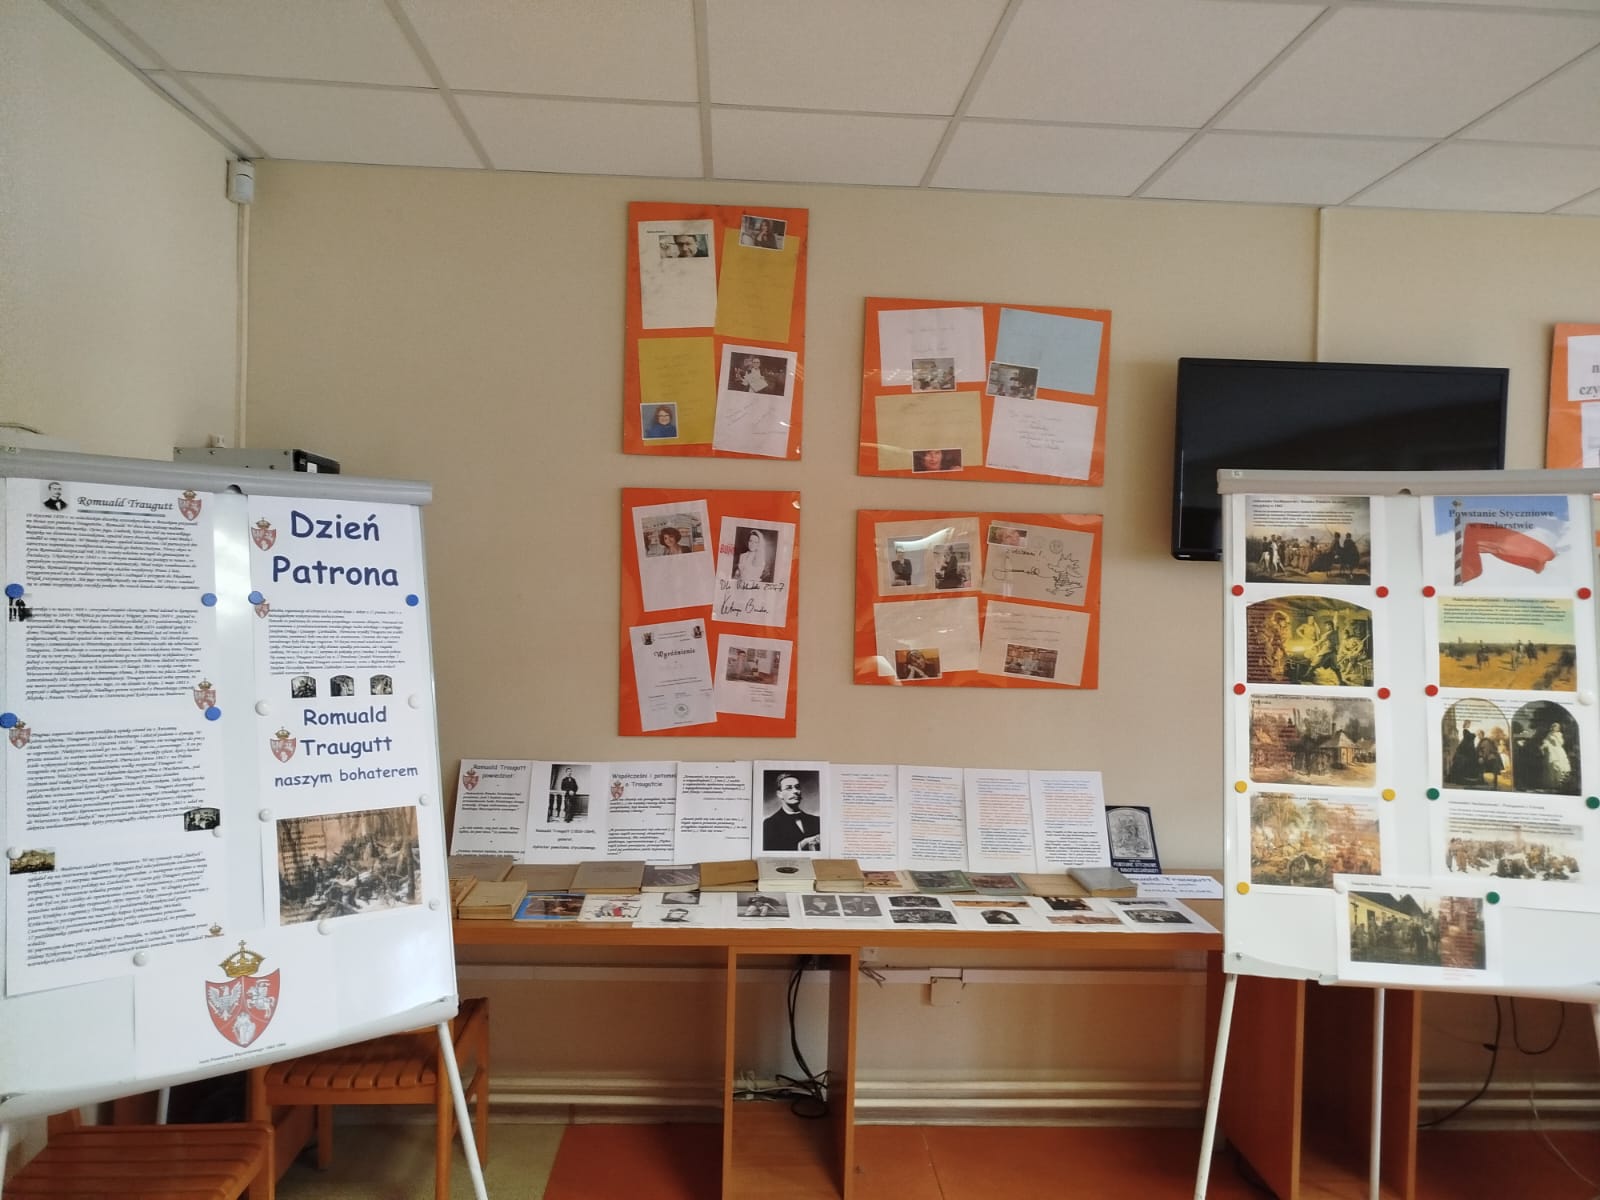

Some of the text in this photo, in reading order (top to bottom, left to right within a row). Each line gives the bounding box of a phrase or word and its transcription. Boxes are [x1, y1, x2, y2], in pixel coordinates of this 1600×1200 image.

[77, 496, 175, 512] Romuald Traugutt
[1448, 508, 1554, 520] Powstanie Styczniowe
[290, 509, 380, 541] Dzień
[1481, 520, 1534, 530] malarstwie
[272, 555, 399, 586] Patrona
[303, 705, 387, 727] Romuald
[300, 736, 393, 759] Traugutt
[274, 765, 418, 789] naszym bohaterem
